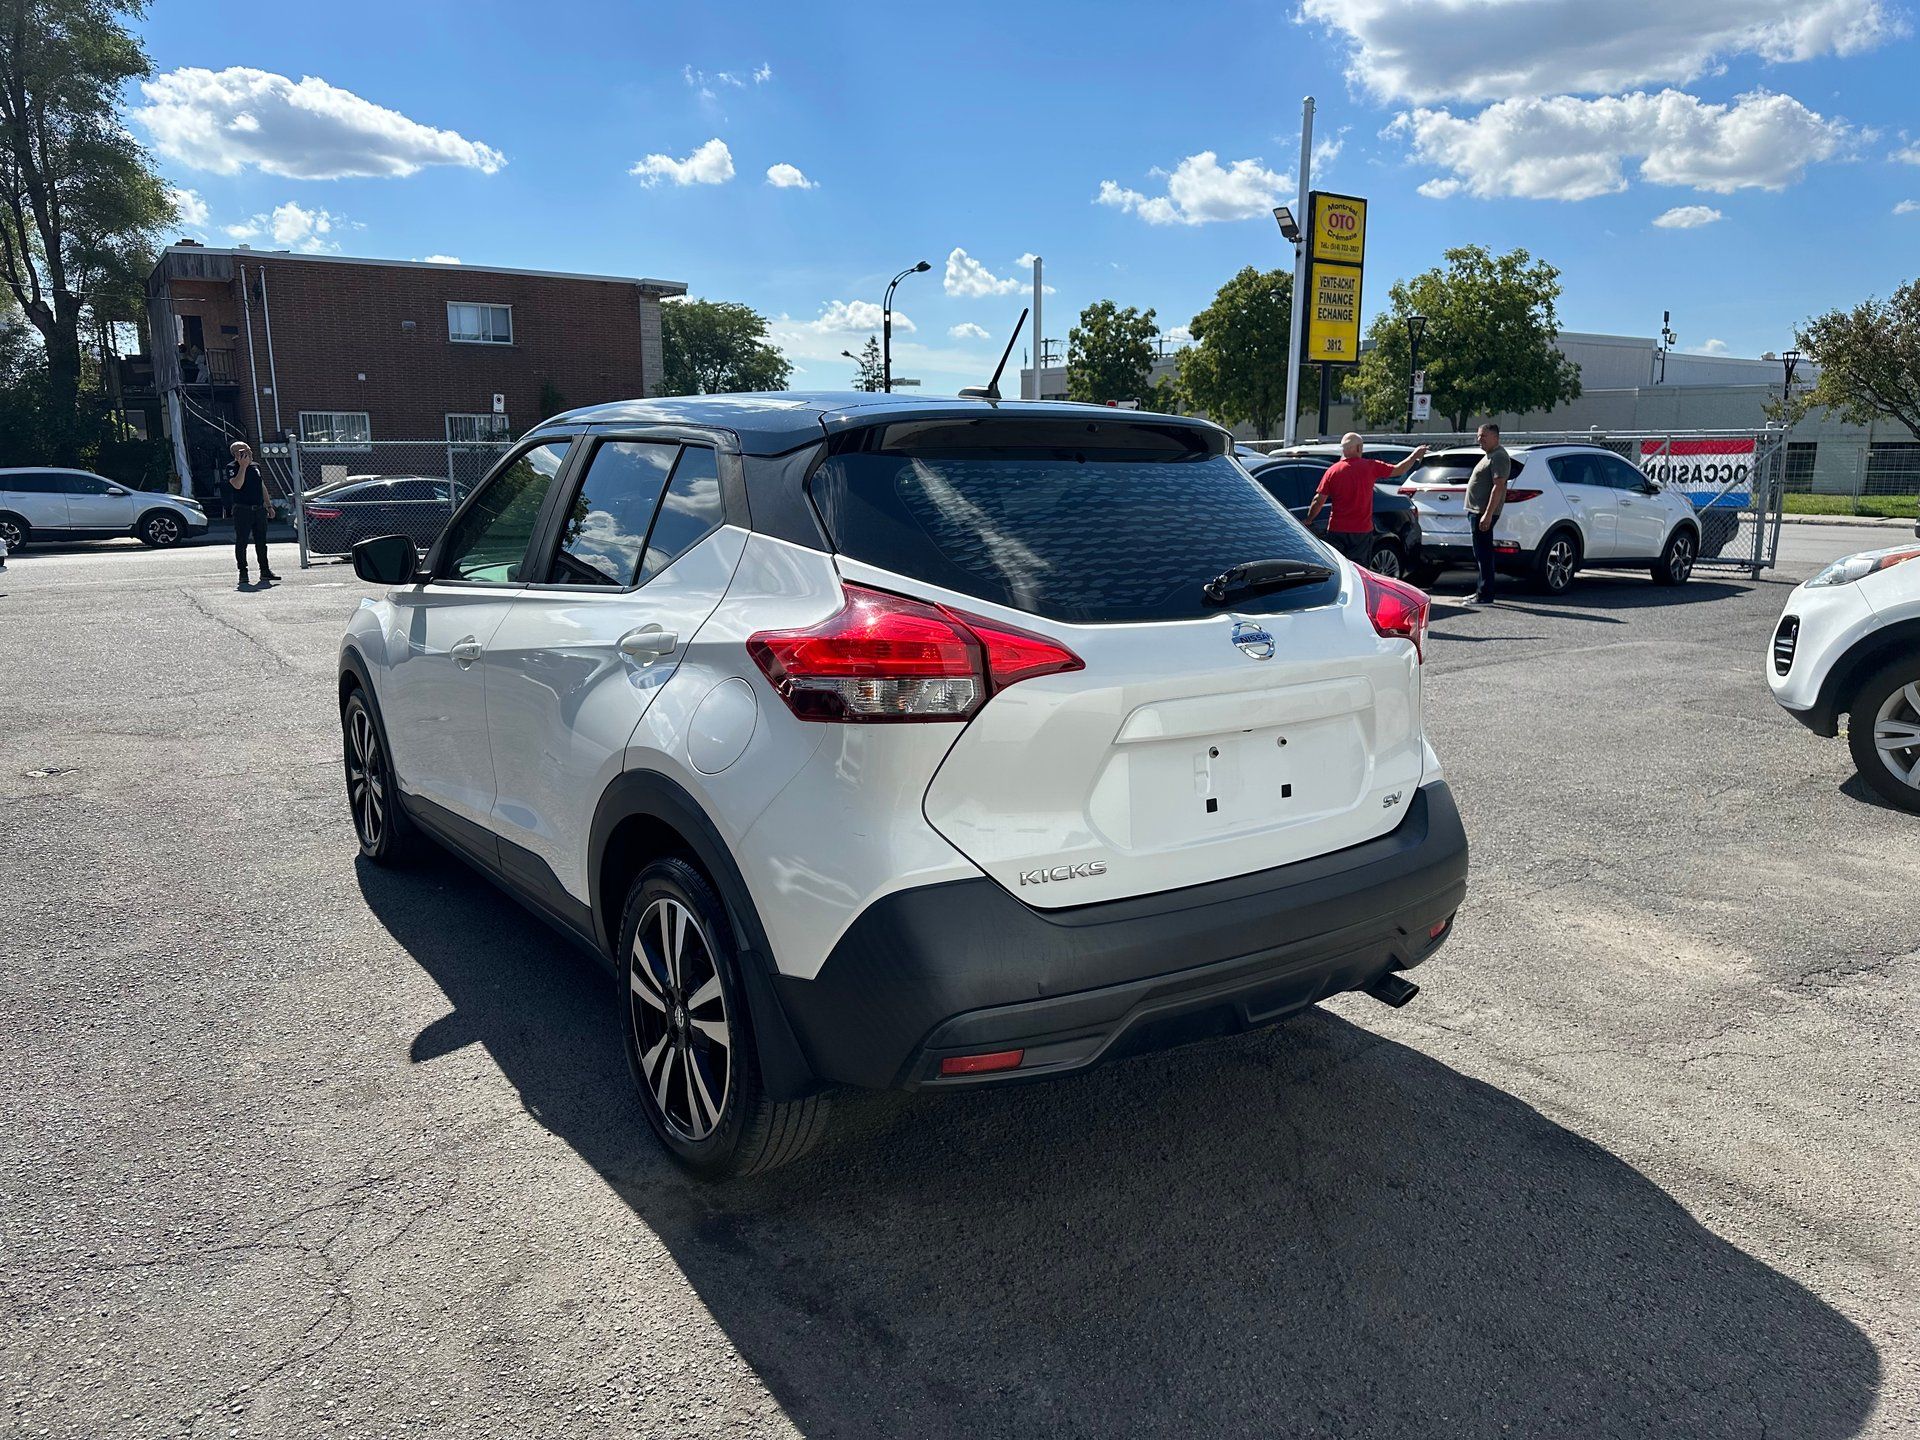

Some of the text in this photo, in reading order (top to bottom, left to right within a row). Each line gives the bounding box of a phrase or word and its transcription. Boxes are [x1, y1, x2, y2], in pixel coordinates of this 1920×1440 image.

[1327, 203, 1358, 216] Montréal
[1329, 213, 1355, 230] OTO
[1327, 229, 1358, 241] Crémazie
[1320, 276, 1355, 290] VENTE-ACHAT
[1319, 291, 1354, 305] FINANCE
[1318, 307, 1353, 321] ECHANGE
[1327, 338, 1342, 351] 3812
[1383, 790, 1402, 808] SV
[1020, 860, 1107, 886] KICKS
